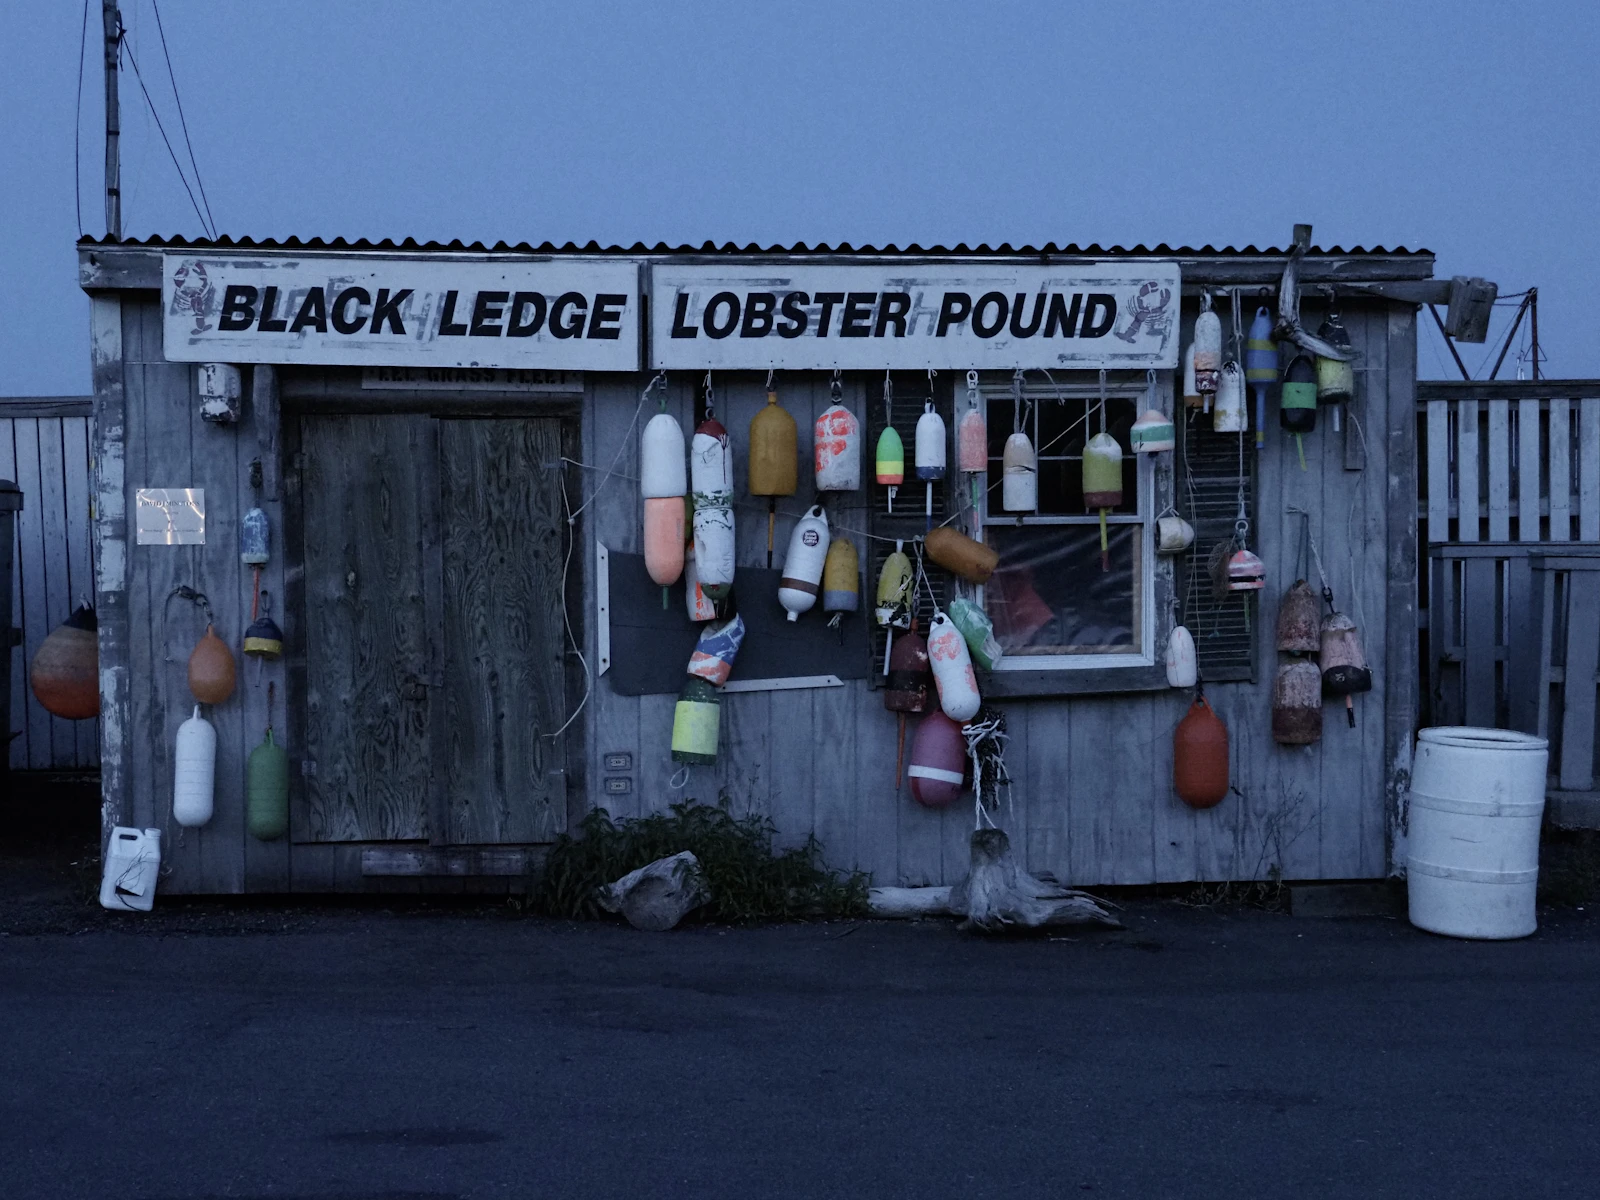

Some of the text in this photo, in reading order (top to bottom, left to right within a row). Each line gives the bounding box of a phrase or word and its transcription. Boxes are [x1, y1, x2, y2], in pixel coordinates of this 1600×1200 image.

[218, 284, 628, 340] BLACK LEDGE
[671, 291, 1117, 340] LOBSTER POUND
[427, 368, 496, 384] GRASS
[507, 369, 568, 385] FLEET
